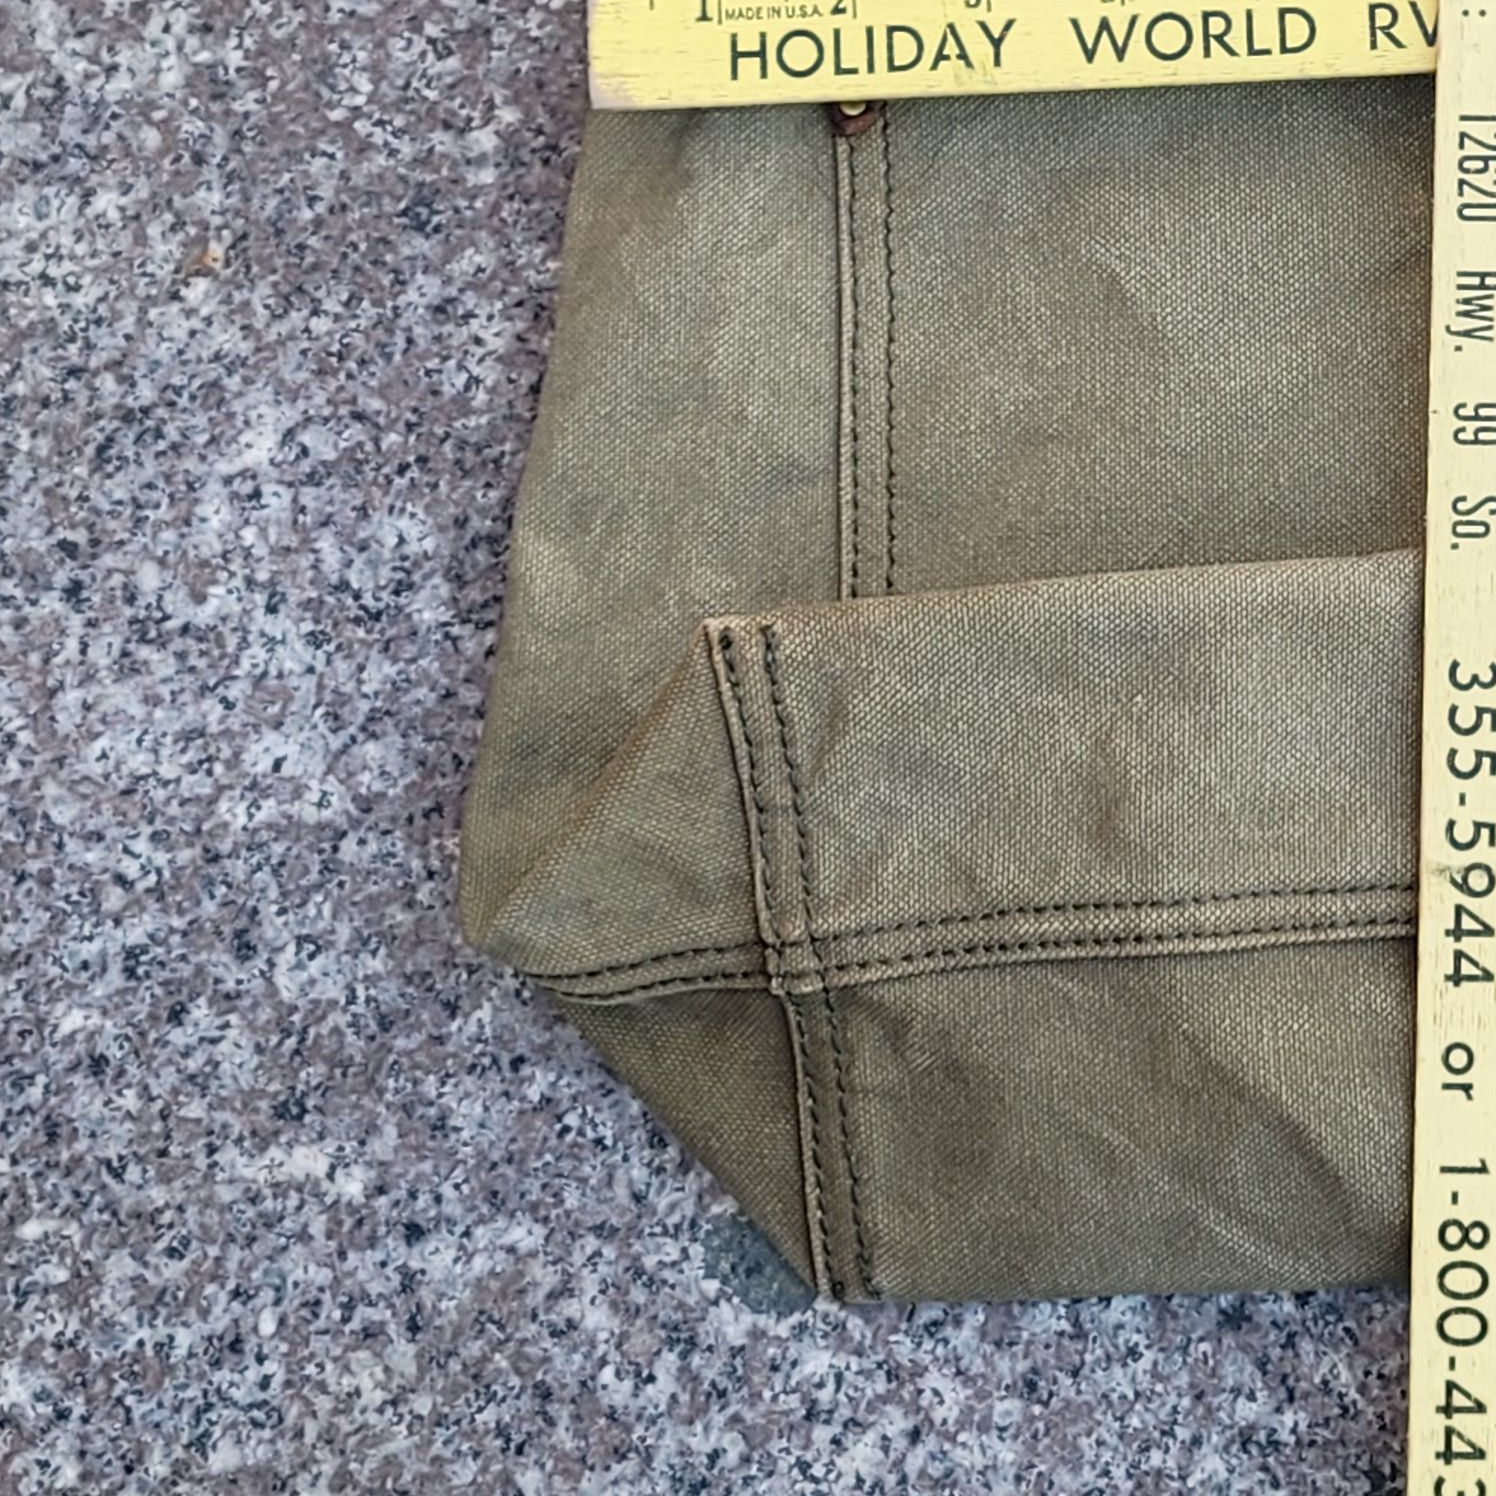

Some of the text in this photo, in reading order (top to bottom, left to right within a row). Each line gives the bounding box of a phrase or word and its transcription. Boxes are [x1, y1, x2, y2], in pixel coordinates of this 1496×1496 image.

[724, 6, 764, 21] MADE
[767, 5, 782, 20] IN
[729, 0, 1438, 82] HOLIDAY WORLD RV
[1441, 1041, 1475, 1101] or
